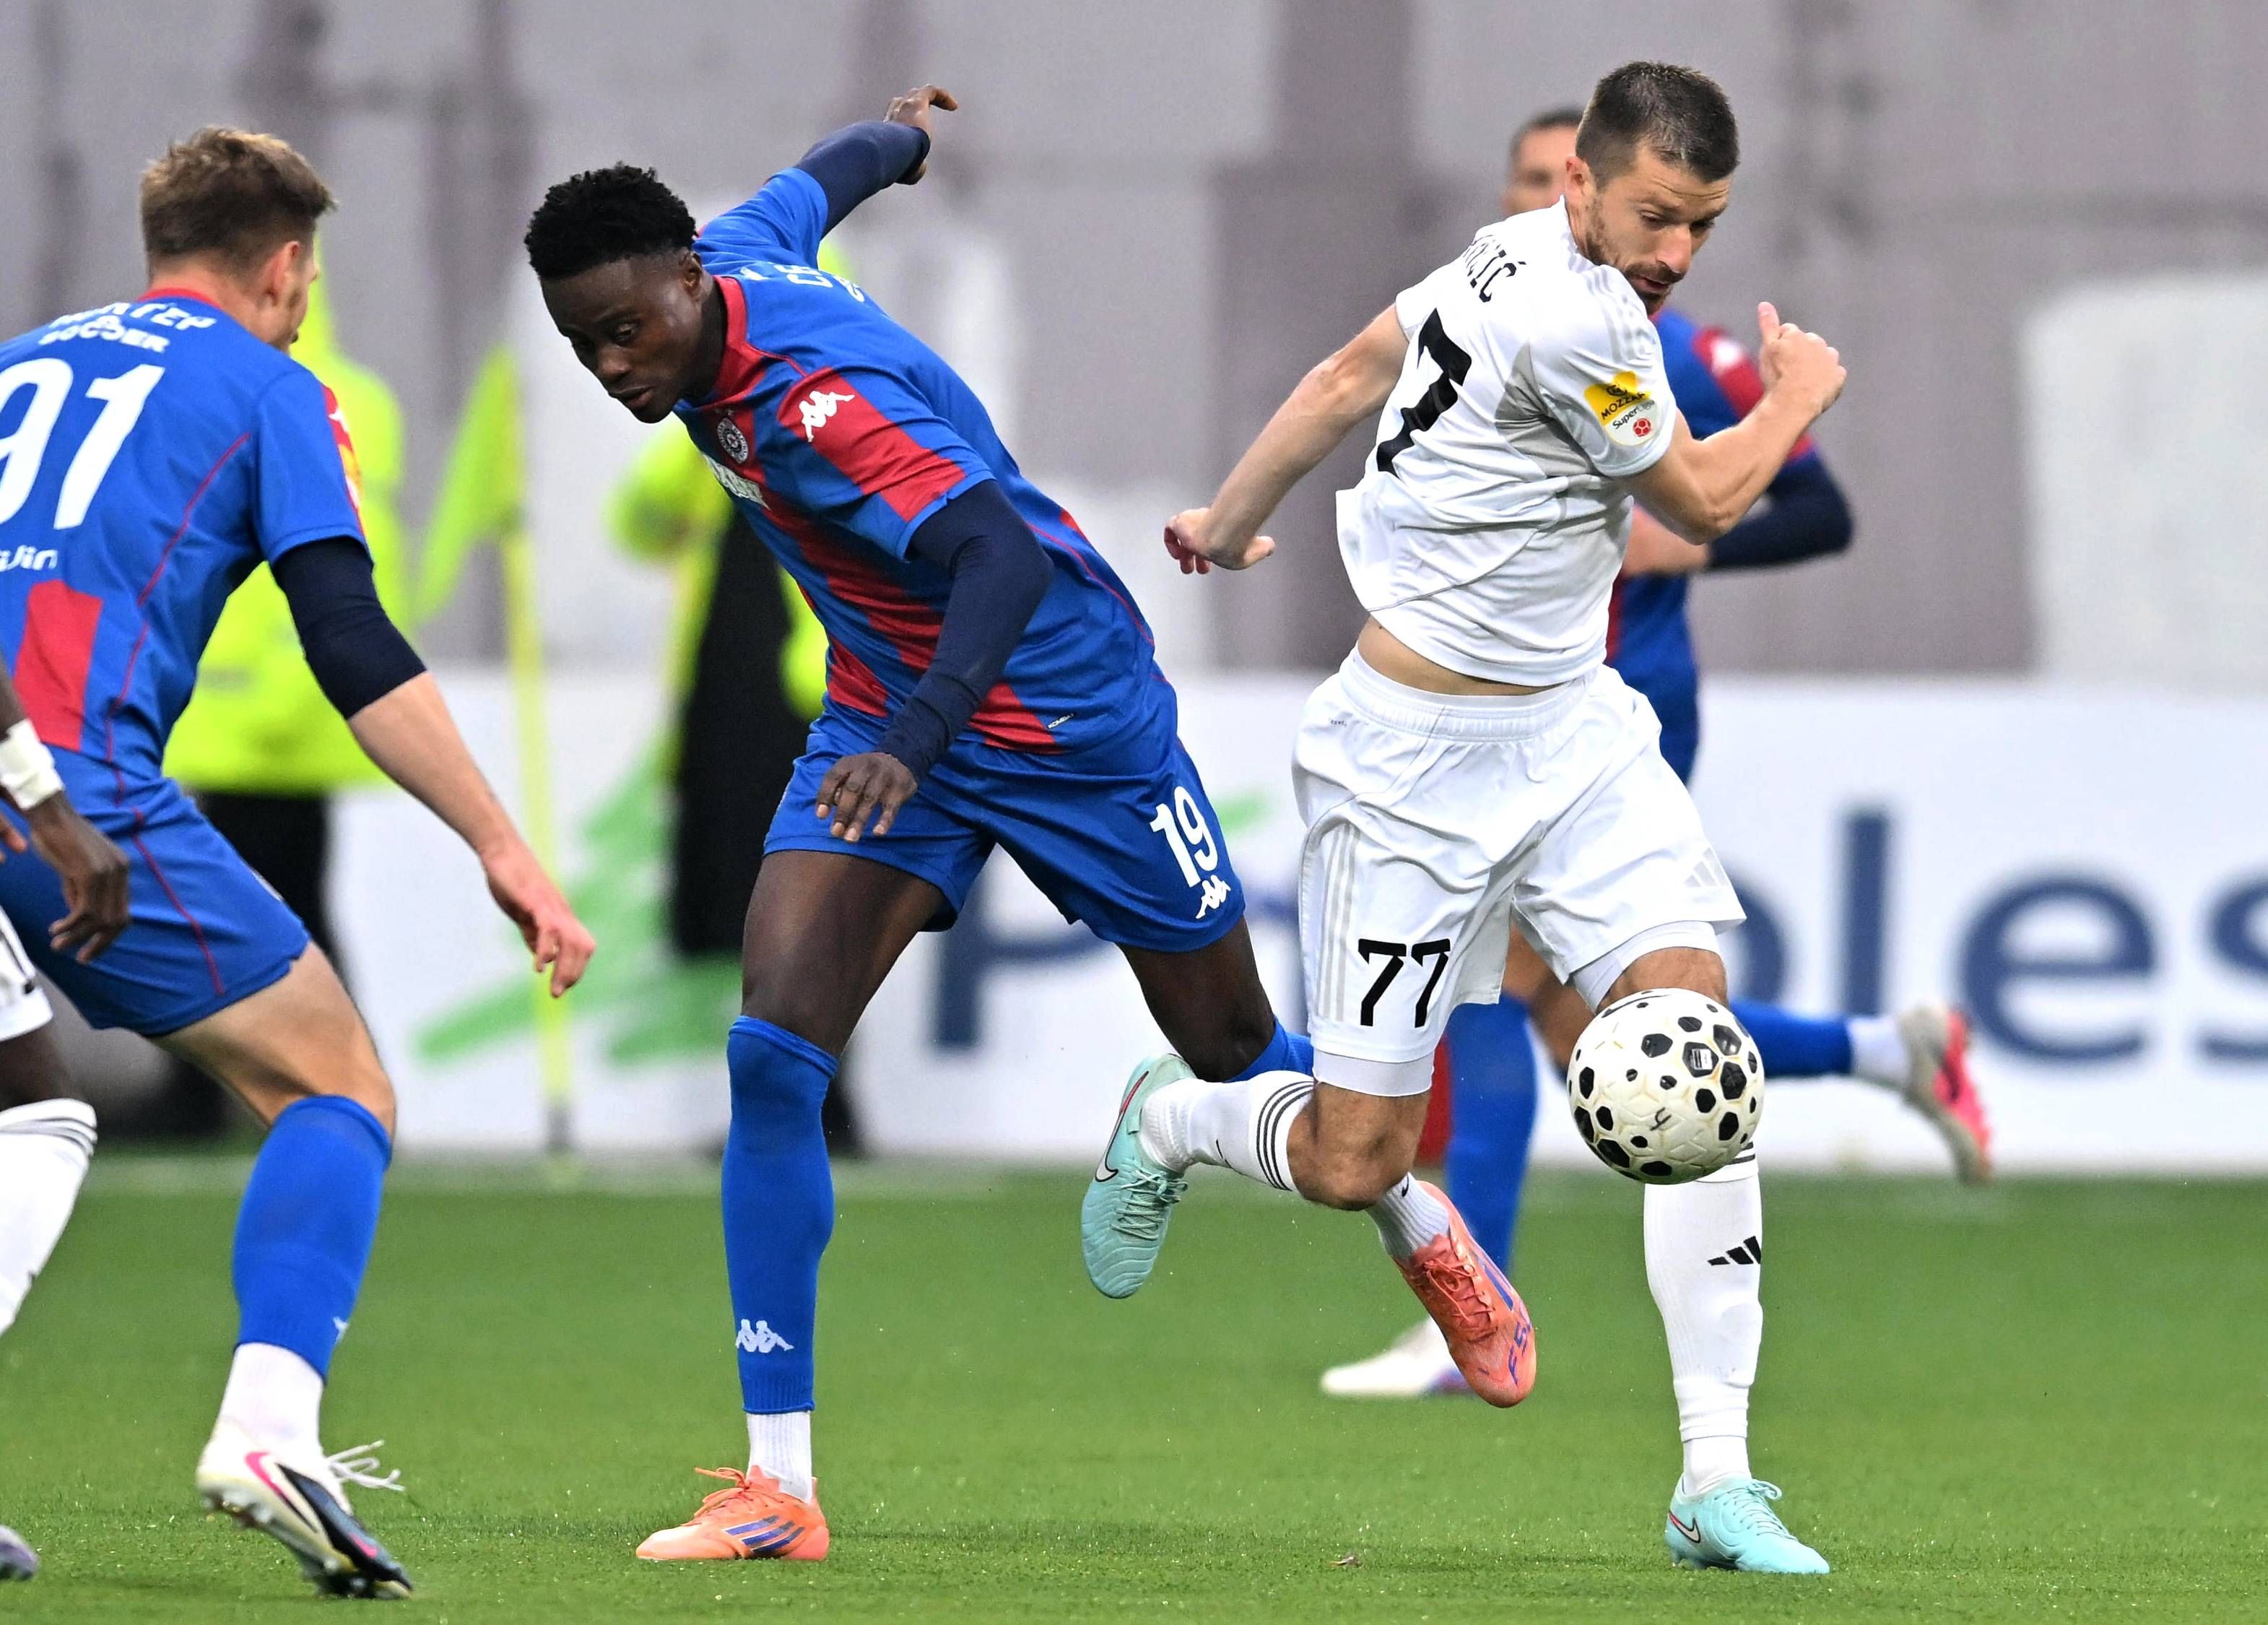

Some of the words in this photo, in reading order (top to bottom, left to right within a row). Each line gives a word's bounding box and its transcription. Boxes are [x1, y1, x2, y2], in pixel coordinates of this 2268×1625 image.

[0, 358, 165, 529] 91
[1150, 786, 1218, 888] 19
[1357, 938, 1451, 1028] 77
